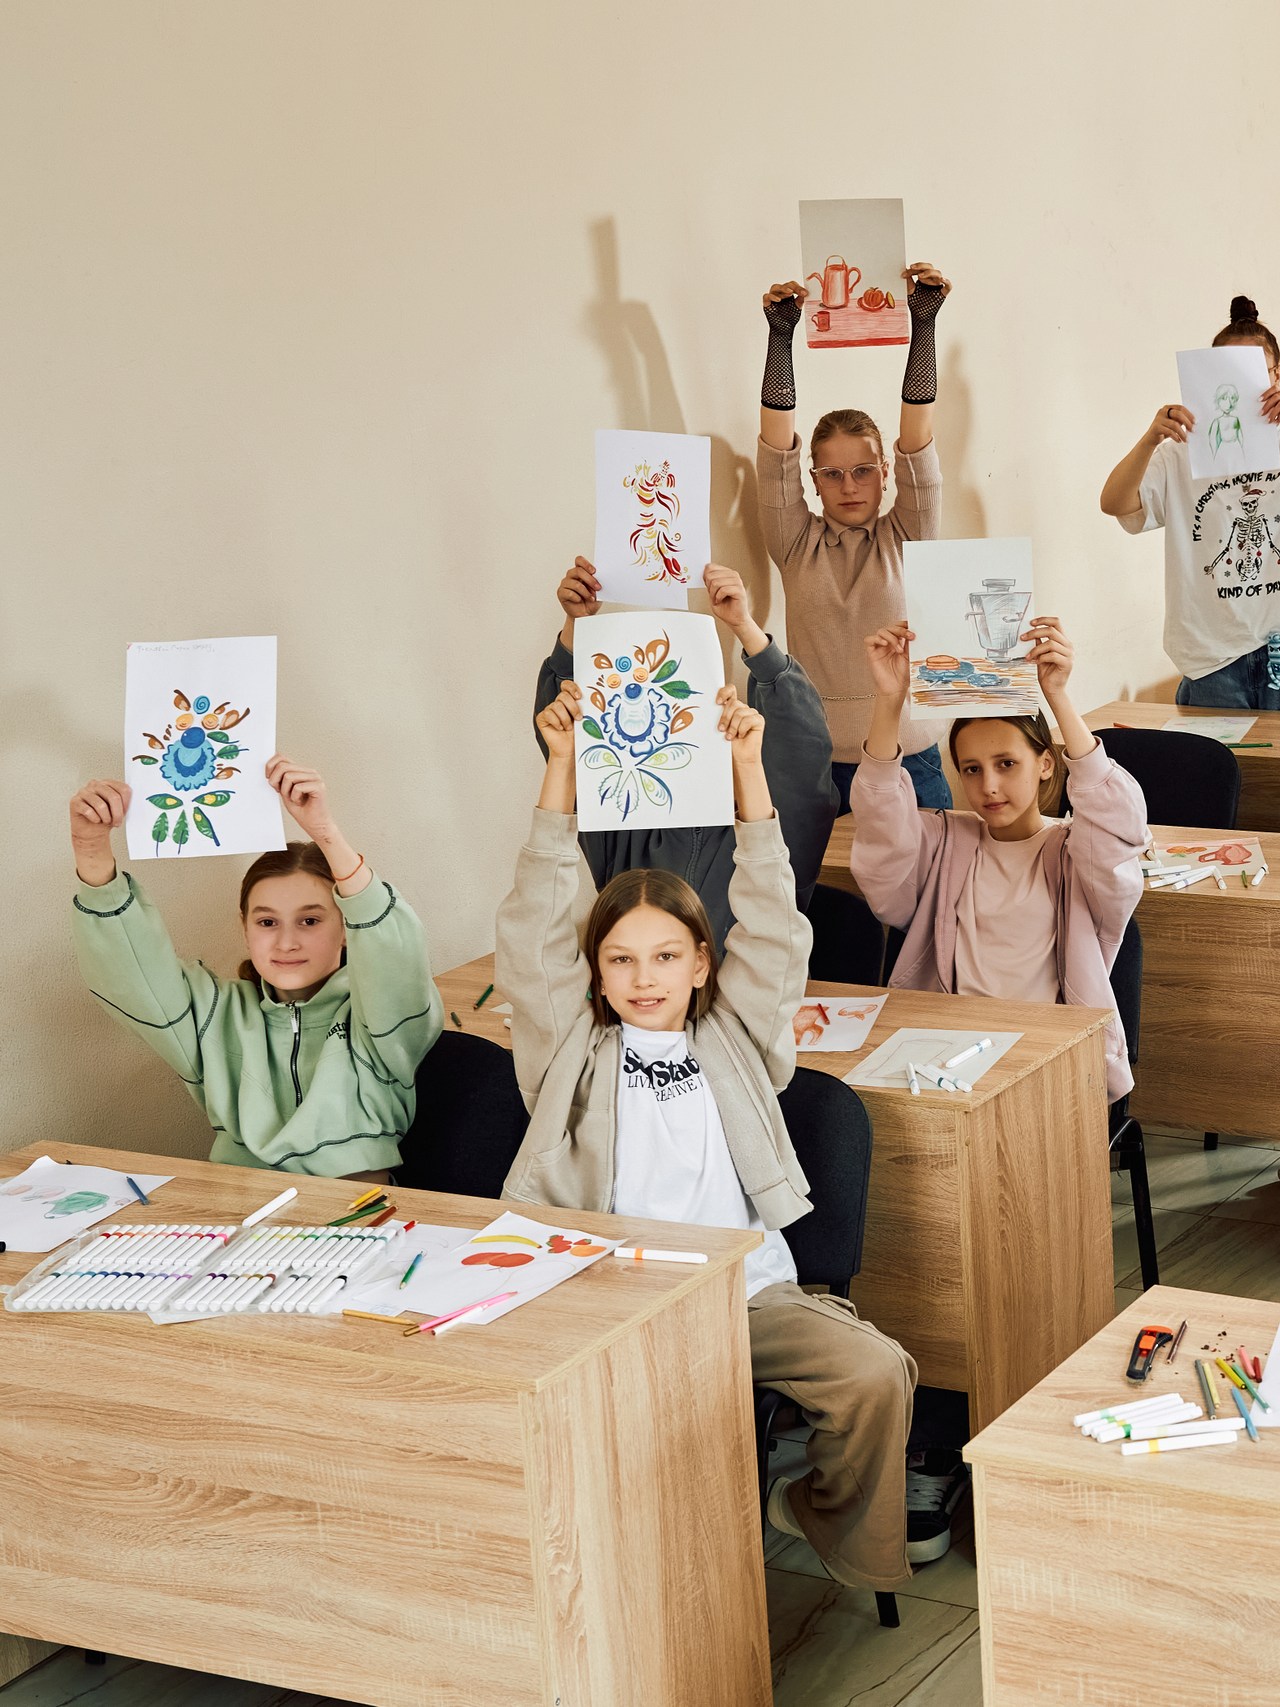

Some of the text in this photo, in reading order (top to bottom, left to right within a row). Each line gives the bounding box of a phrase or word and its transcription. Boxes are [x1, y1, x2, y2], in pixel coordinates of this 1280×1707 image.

[1232, 471, 1264, 486] MOVIE
[1217, 585, 1243, 599] KIND
[1245, 584, 1263, 597] OF
